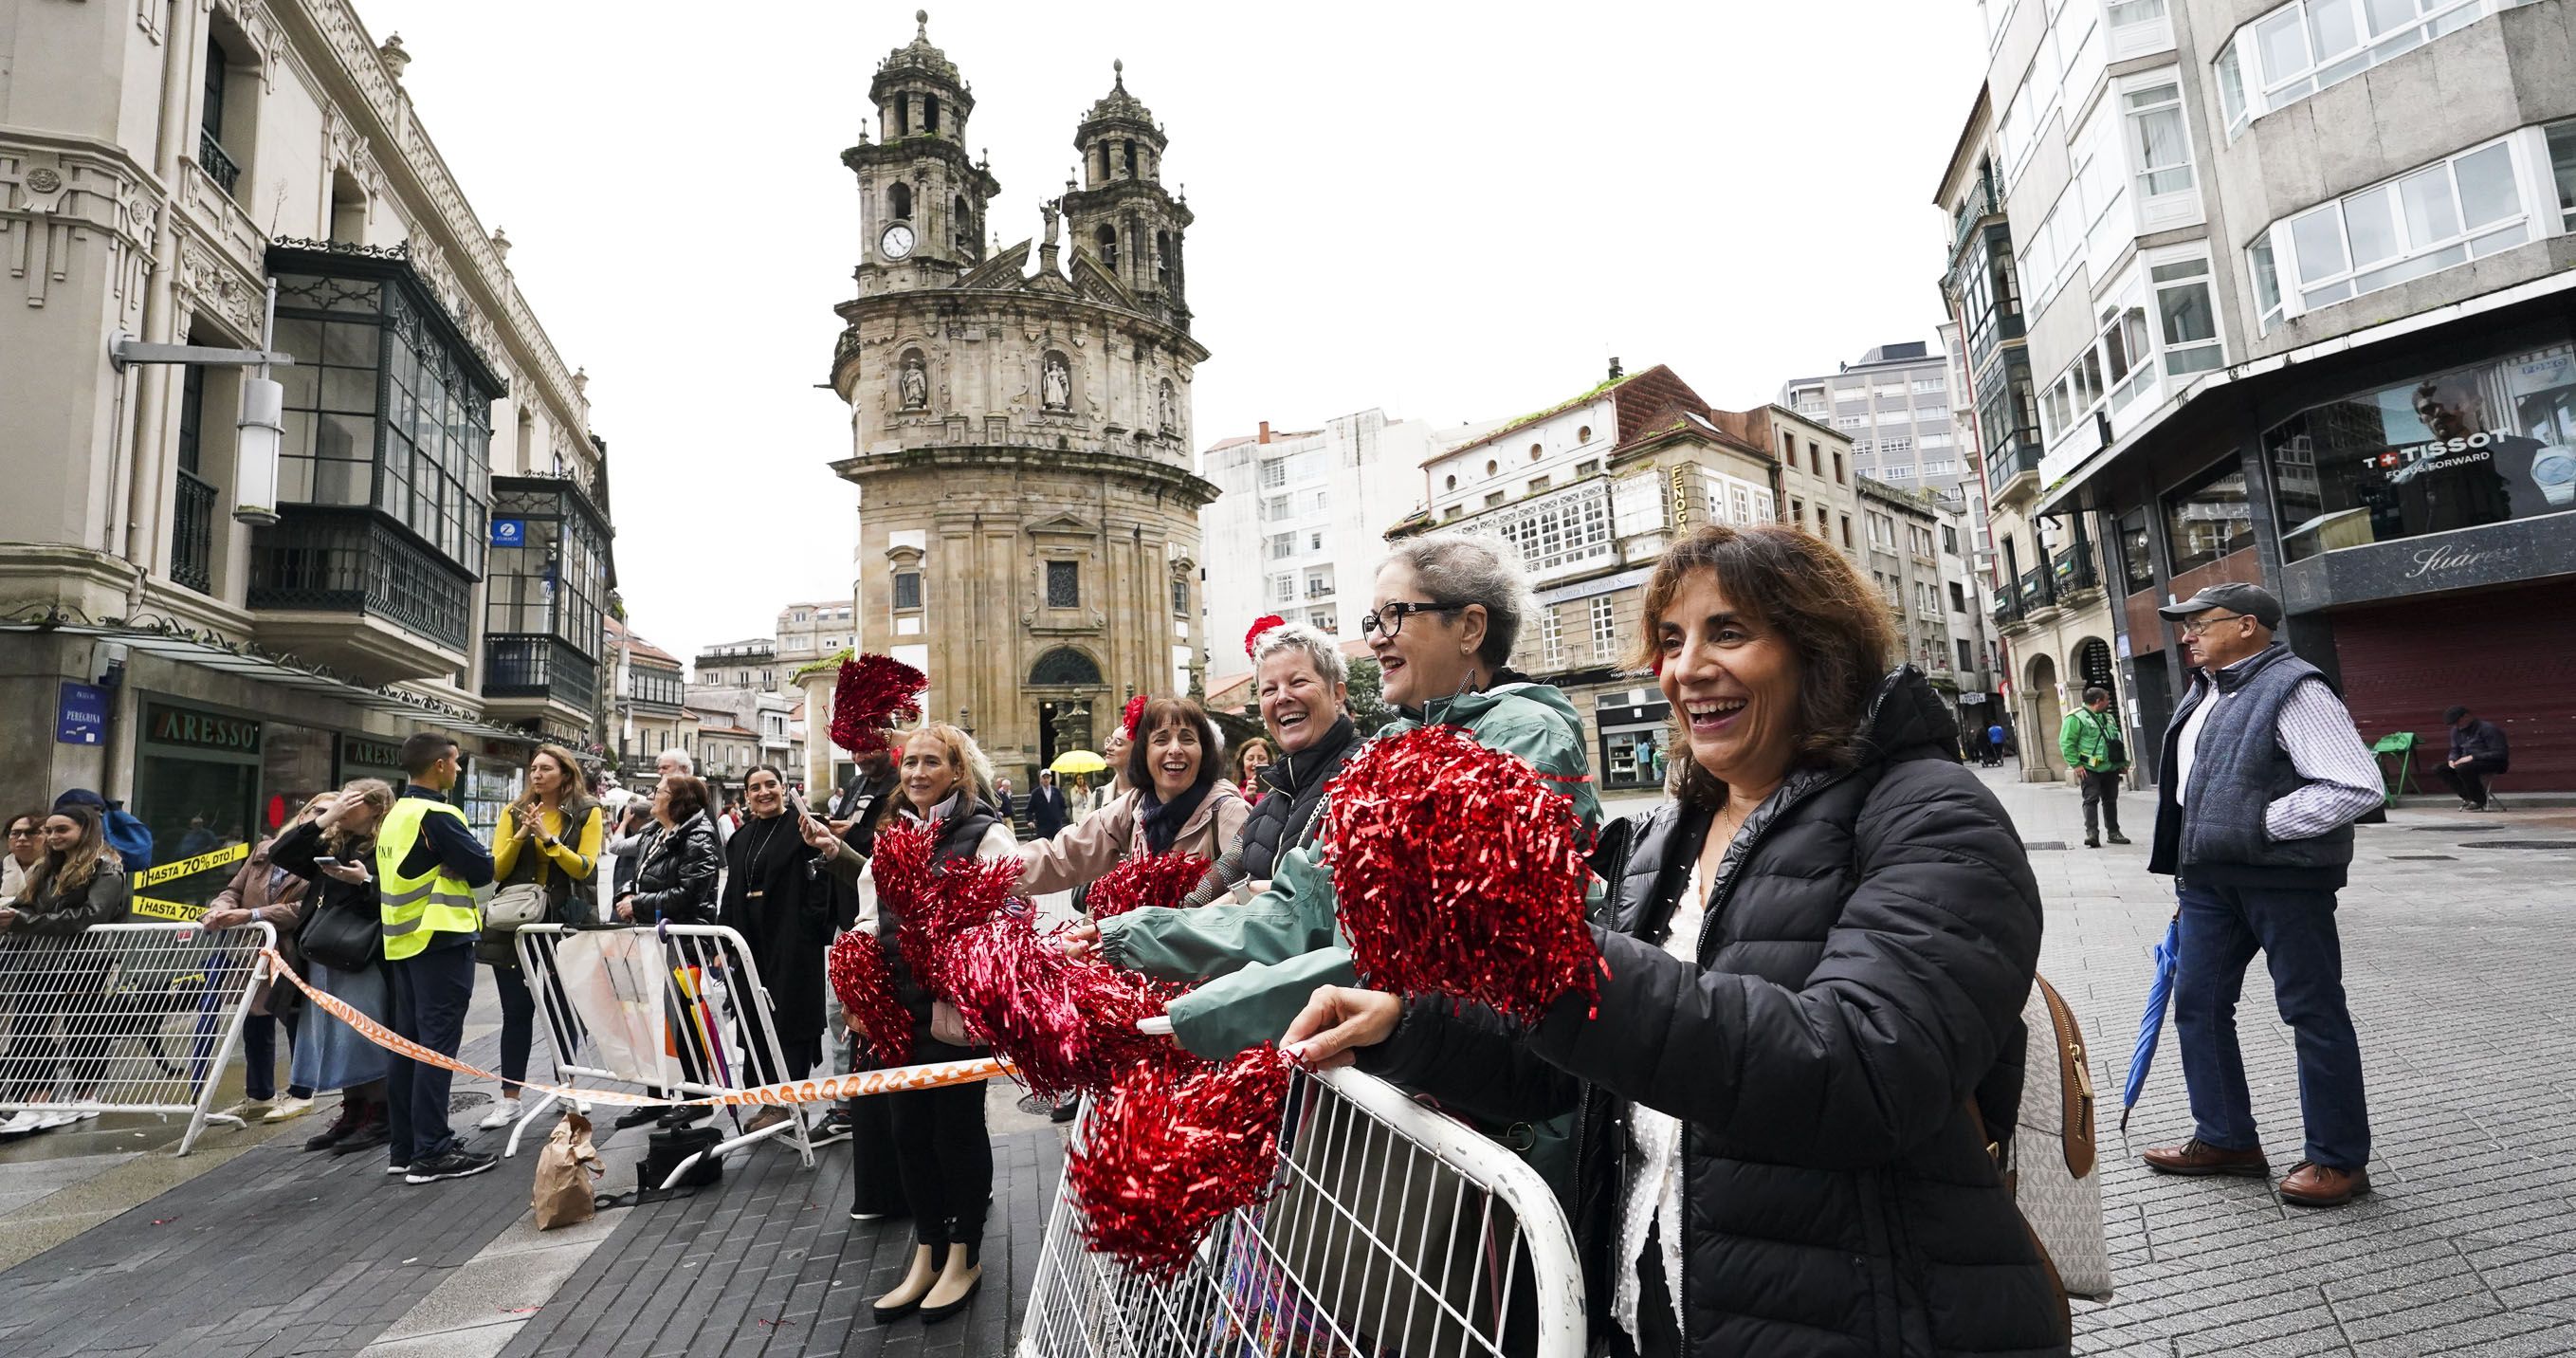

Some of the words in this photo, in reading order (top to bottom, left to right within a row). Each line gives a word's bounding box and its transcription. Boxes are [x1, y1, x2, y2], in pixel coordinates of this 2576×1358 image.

[2400, 428, 2512, 463] TISSOT
[2385, 464, 2427, 479] FOCUS
[2427, 451, 2491, 471] FORWARD
[1555, 587, 1581, 600] Alianza
[1581, 578, 1617, 595] Española
[66, 710, 100, 725] PEREGRINA
[163, 711, 254, 748] ARESSO
[181, 855, 210, 875] 70%
